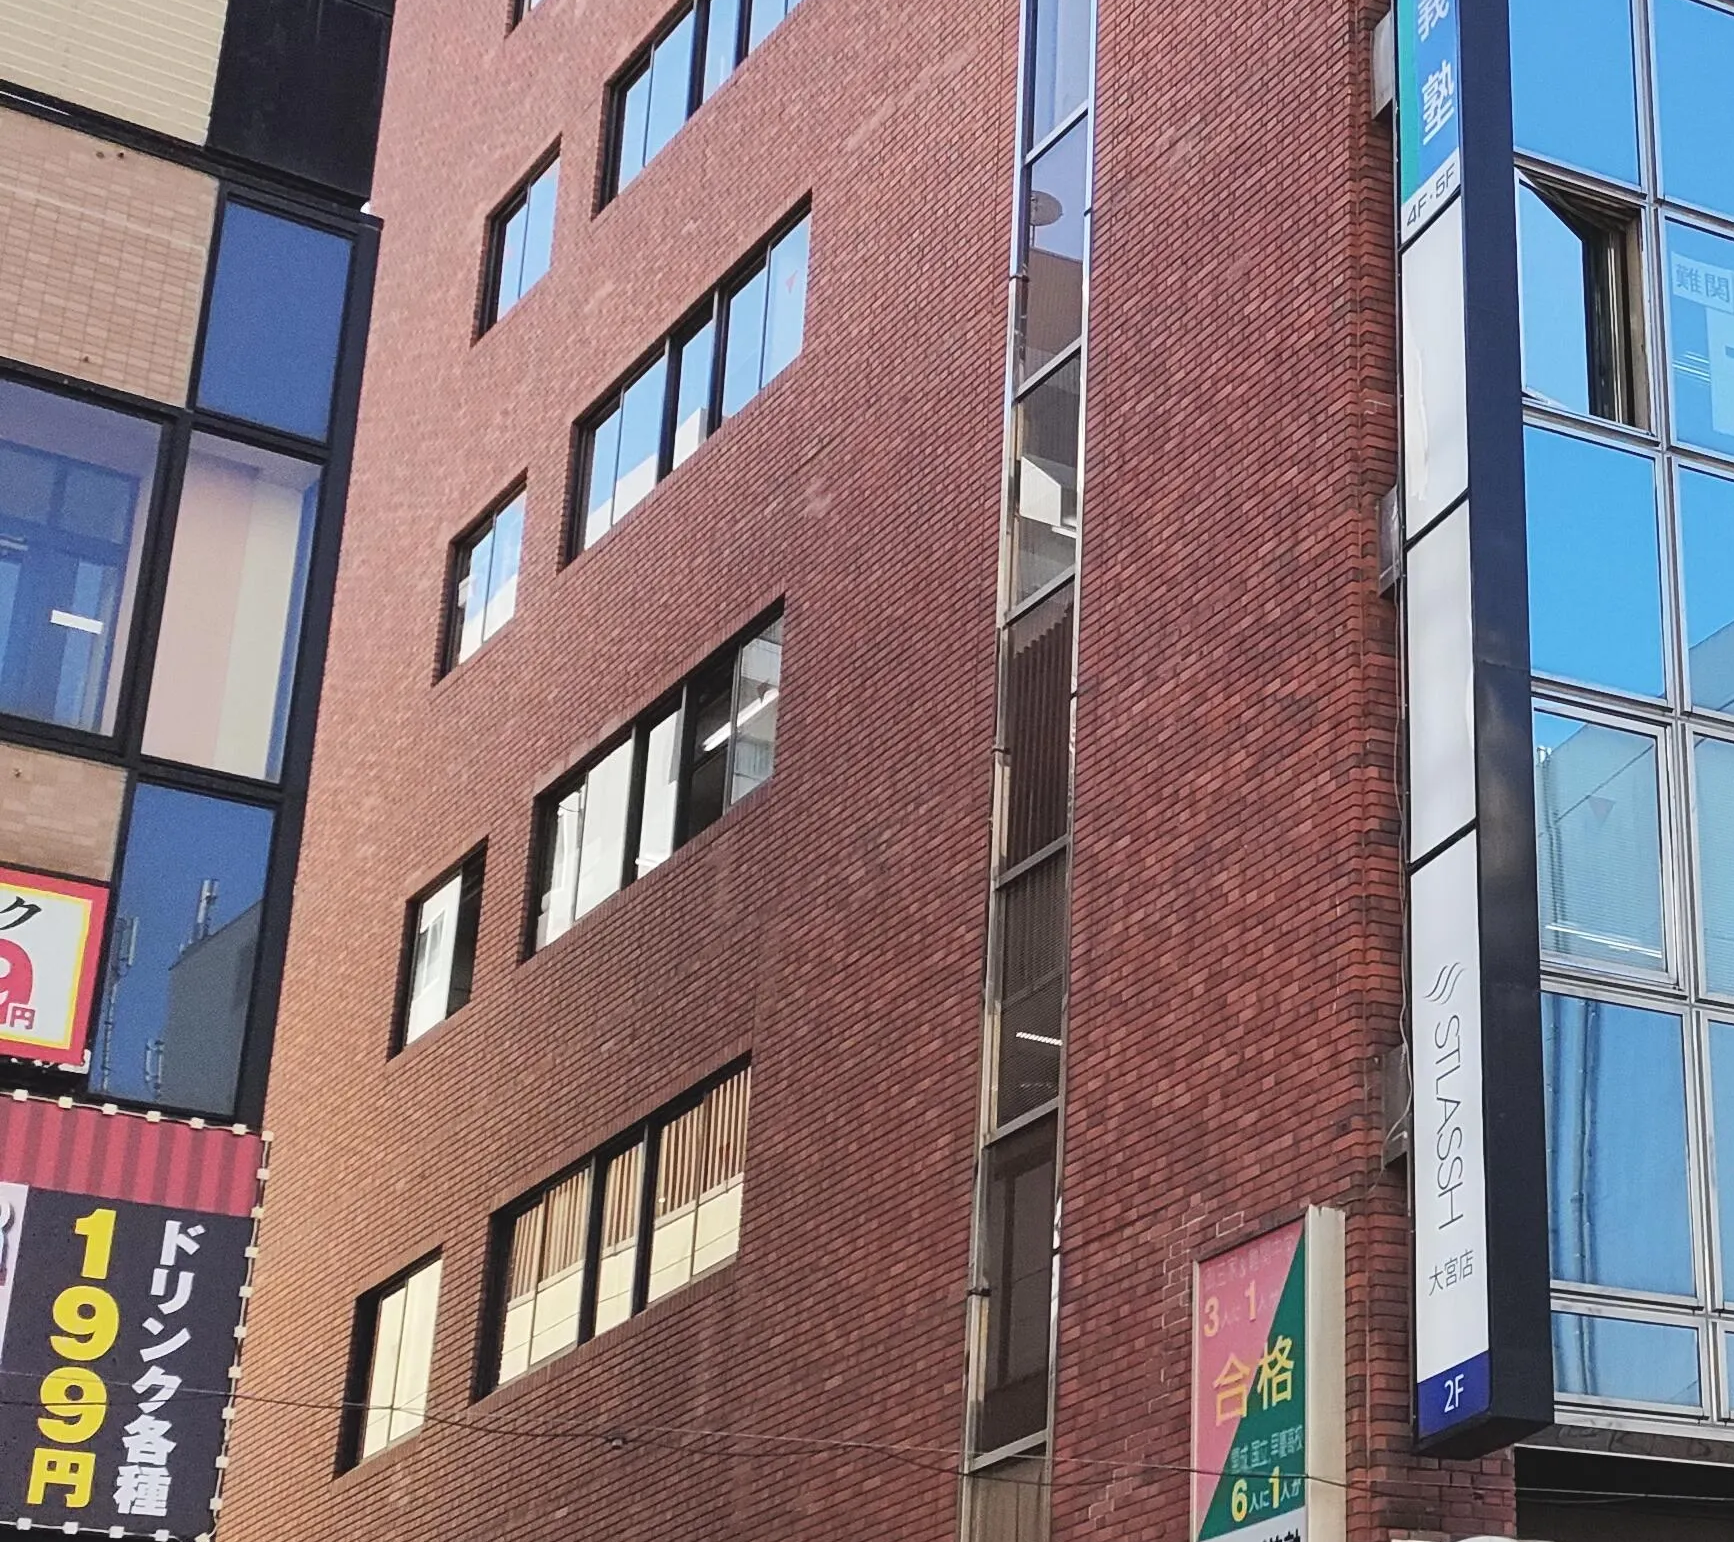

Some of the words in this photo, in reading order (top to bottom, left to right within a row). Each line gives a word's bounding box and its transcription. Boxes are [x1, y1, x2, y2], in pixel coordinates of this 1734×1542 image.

[1433, 1013, 1463, 1229] STLASSH
[1427, 1248, 1474, 1296] 大宮店
[27, 1208, 119, 1508] 199円
[112, 1220, 207, 1517] ドリンク各種
[1212, 1335, 1295, 1427] 合格
[1443, 1373, 1465, 1415] 2F
